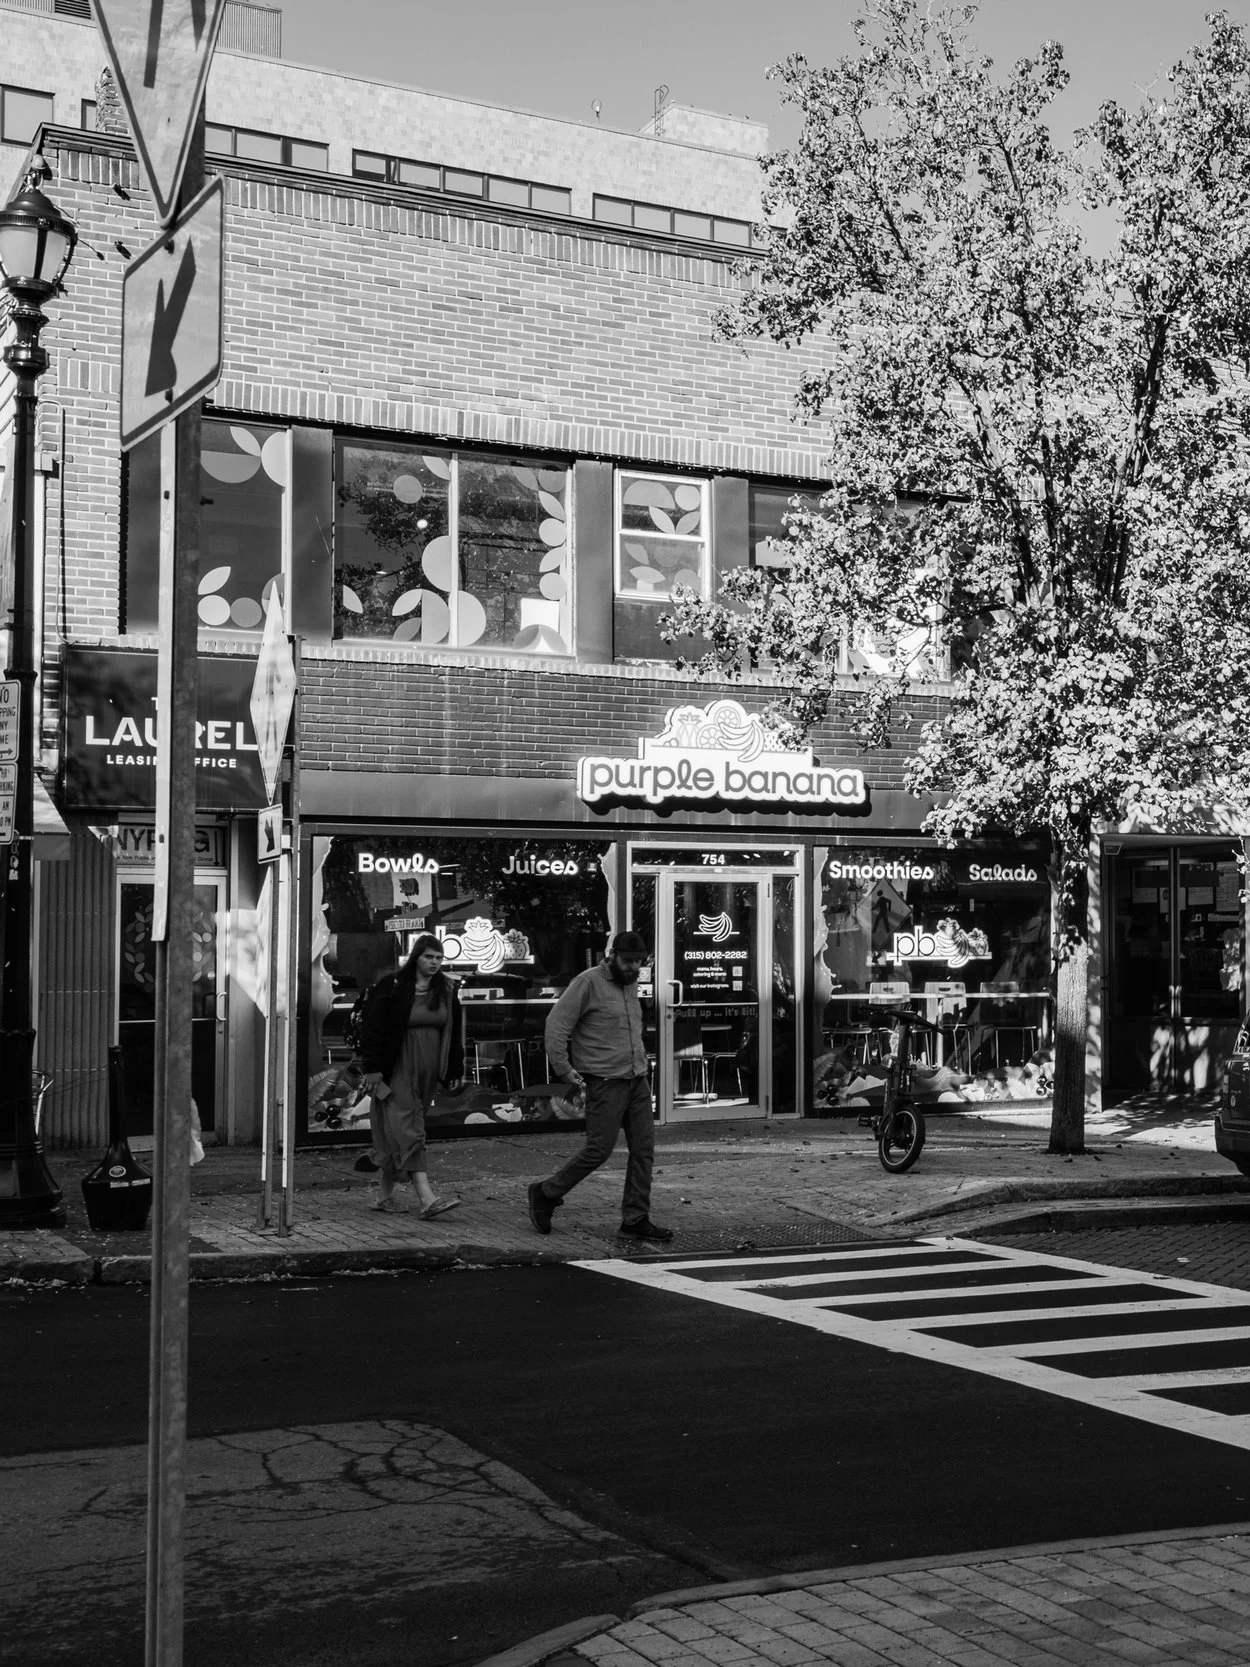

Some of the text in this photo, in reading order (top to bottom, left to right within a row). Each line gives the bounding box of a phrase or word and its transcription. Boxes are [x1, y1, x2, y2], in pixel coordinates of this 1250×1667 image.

[0, 706, 16, 718] PPING
[0, 721, 8, 731] NY
[106, 754, 237, 768] LEASI FFICE
[589, 759, 859, 797] purple banana
[358, 853, 440, 874] Bowls
[501, 854, 579, 876] Juices
[702, 854, 726, 865] 754
[829, 860, 934, 880] Smoothies
[969, 864, 1038, 881] Salads
[896, 928, 936, 961] pb
[684, 951, 747, 960] (315) 802-2282
[700, 1010, 711, 1019] up
